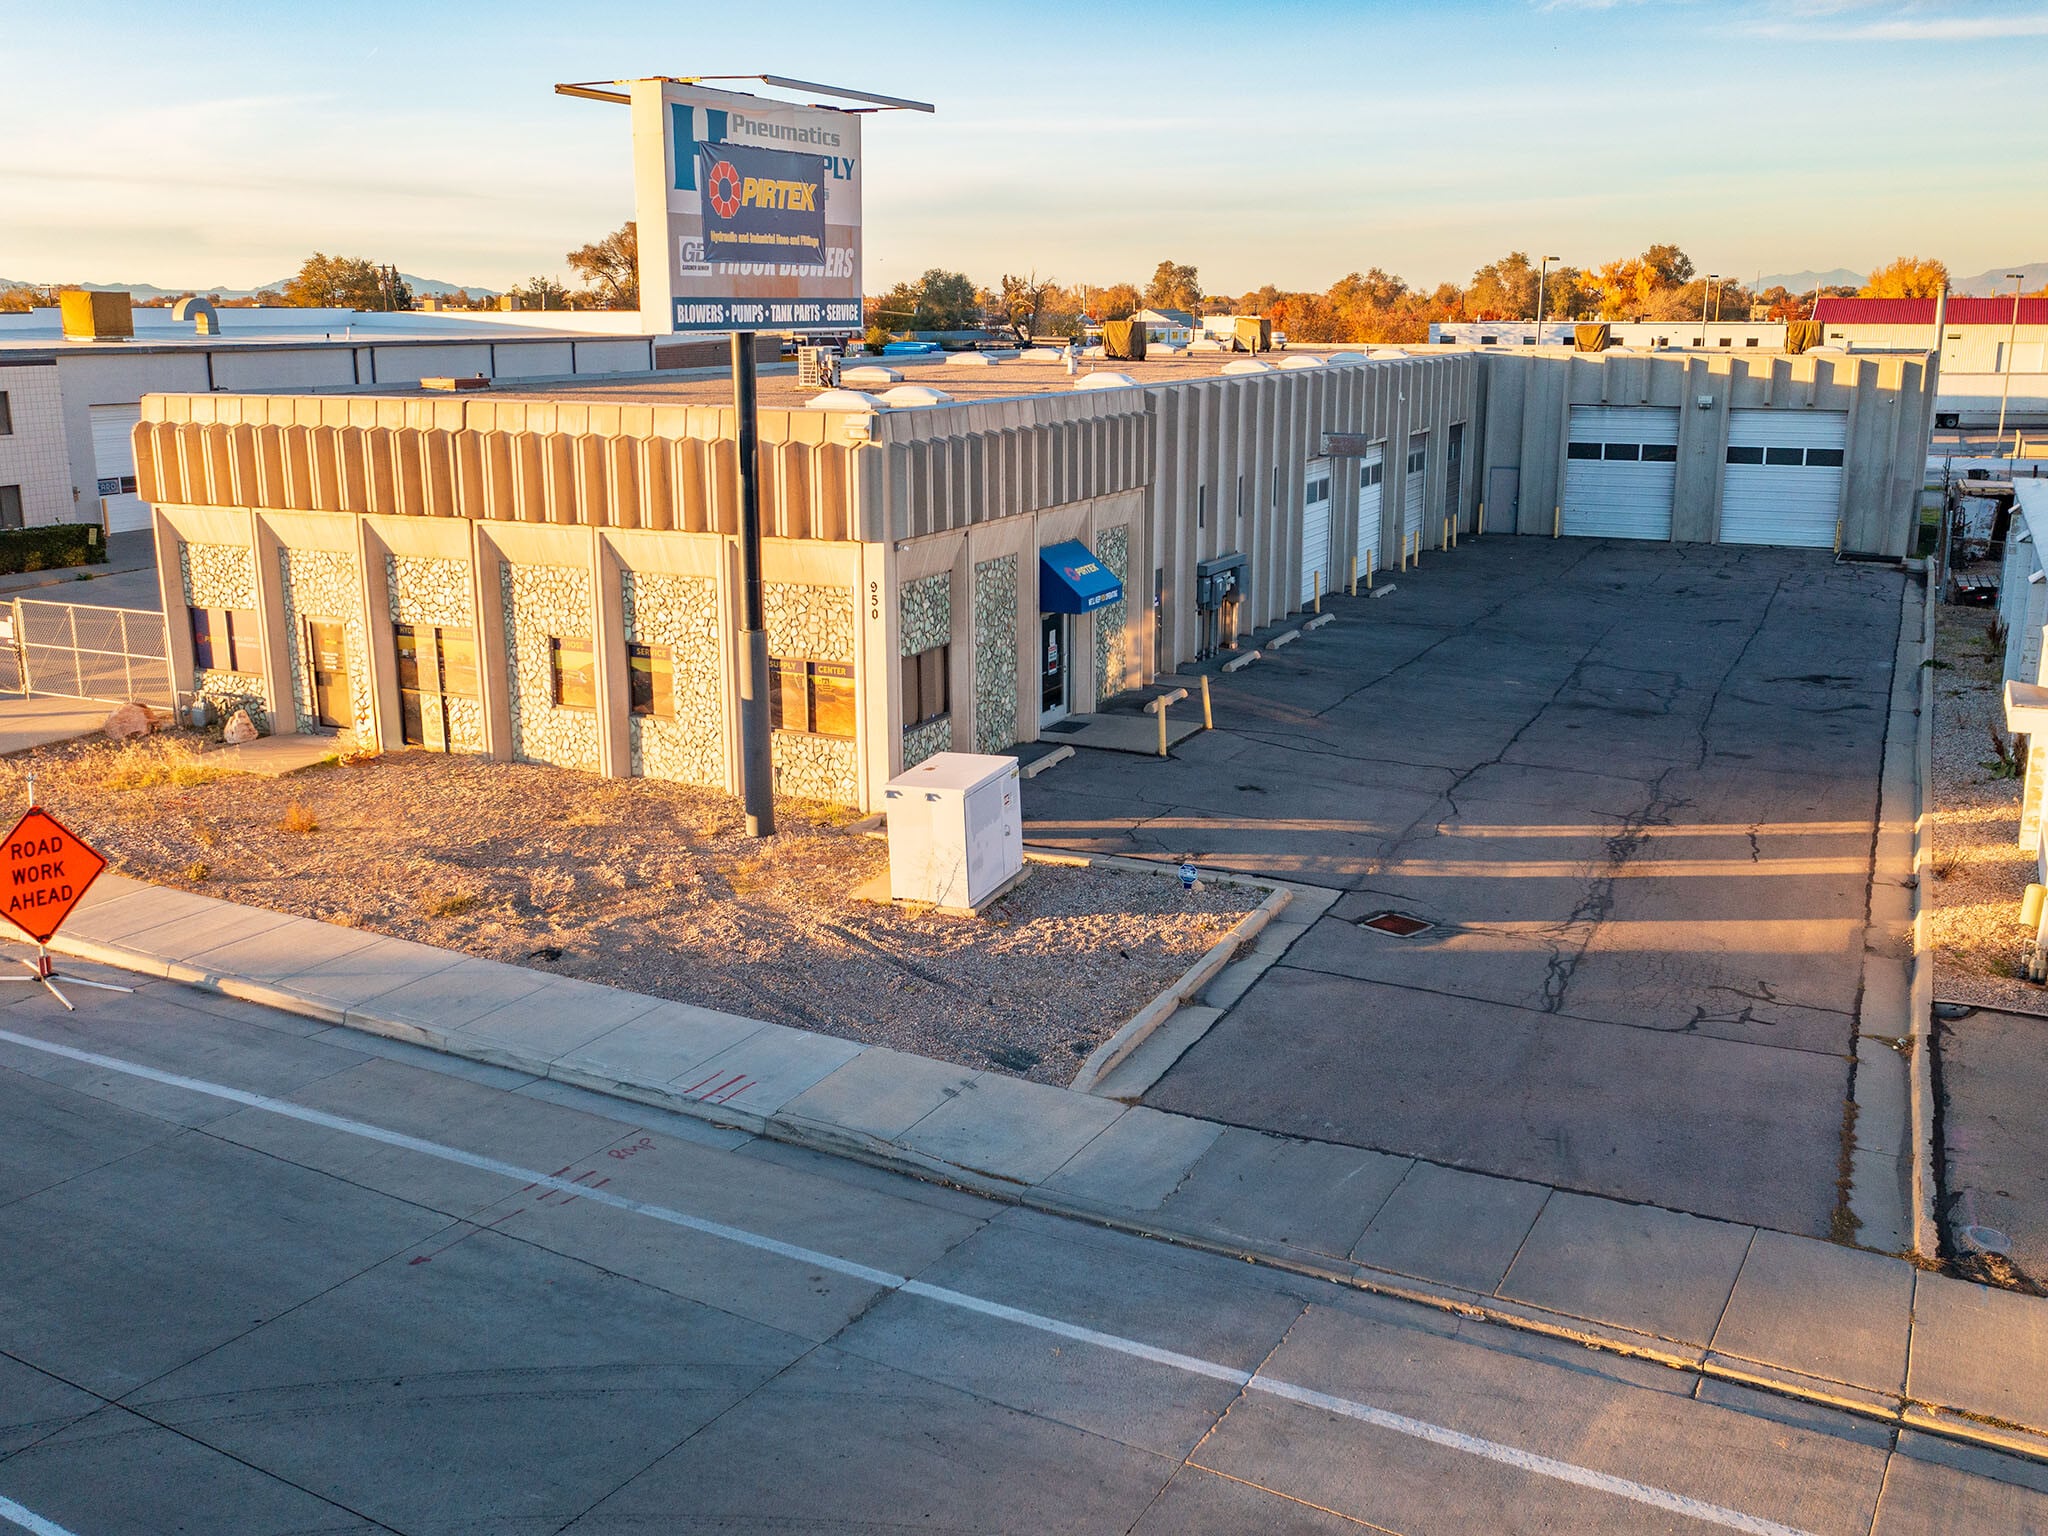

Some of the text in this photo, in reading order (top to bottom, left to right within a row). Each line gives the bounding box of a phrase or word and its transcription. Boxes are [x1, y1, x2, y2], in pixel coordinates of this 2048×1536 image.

[732, 113, 840, 147] Pneumatics
[823, 155, 855, 180] PLY
[741, 177, 818, 212] PIRTEX
[677, 304, 859, 323] BLOWERS PUMPS TANK PARTS SERVICE
[870, 581, 879, 620] 950
[636, 647, 667, 658] SERVICE
[769, 660, 846, 676] SUPPLY CENTER
[11, 836, 63, 860] ROAD
[12, 861, 65, 886] WORK
[9, 885, 73, 912] AHEAD
